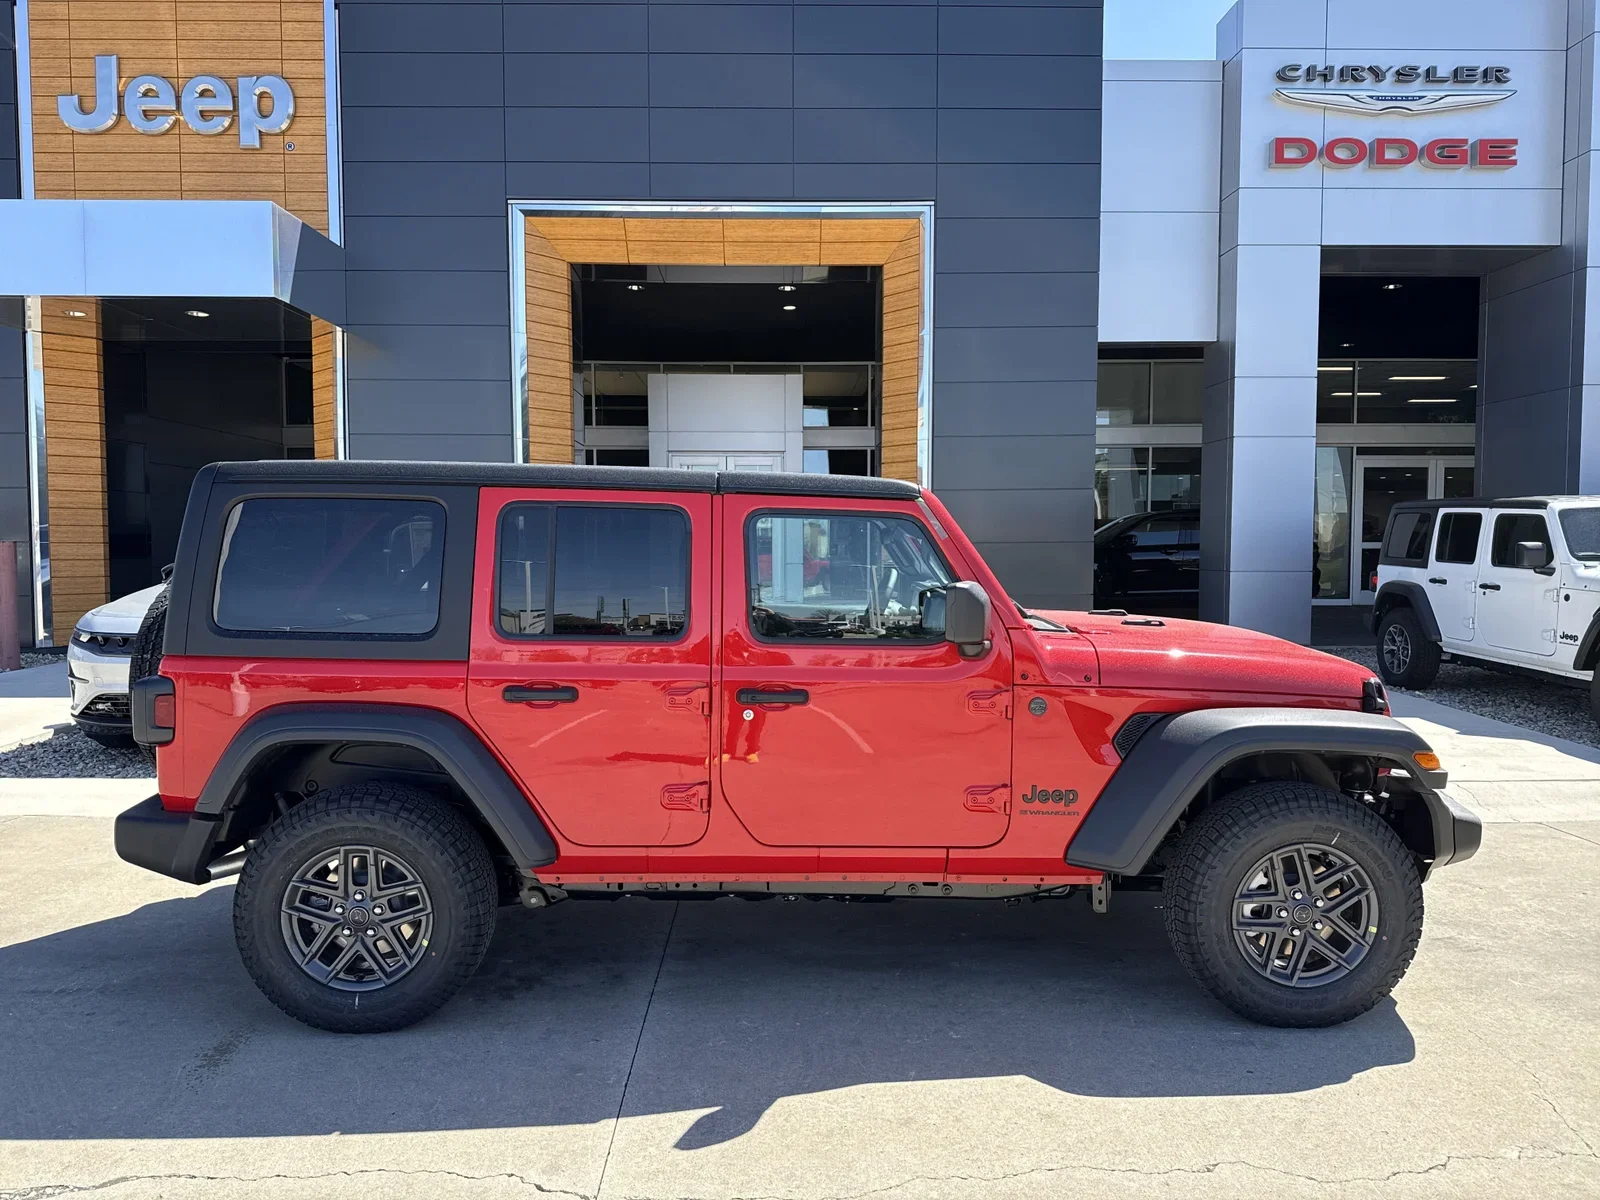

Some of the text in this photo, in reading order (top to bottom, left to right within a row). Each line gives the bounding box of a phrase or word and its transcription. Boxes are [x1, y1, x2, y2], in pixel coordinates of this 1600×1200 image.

[1276, 63, 1512, 84] CHRYSLER
[57, 54, 296, 149] Jeep
[1270, 136, 1519, 169] DODGE
[1560, 631, 1578, 642] Jeep
[1022, 785, 1078, 807] Jeep
